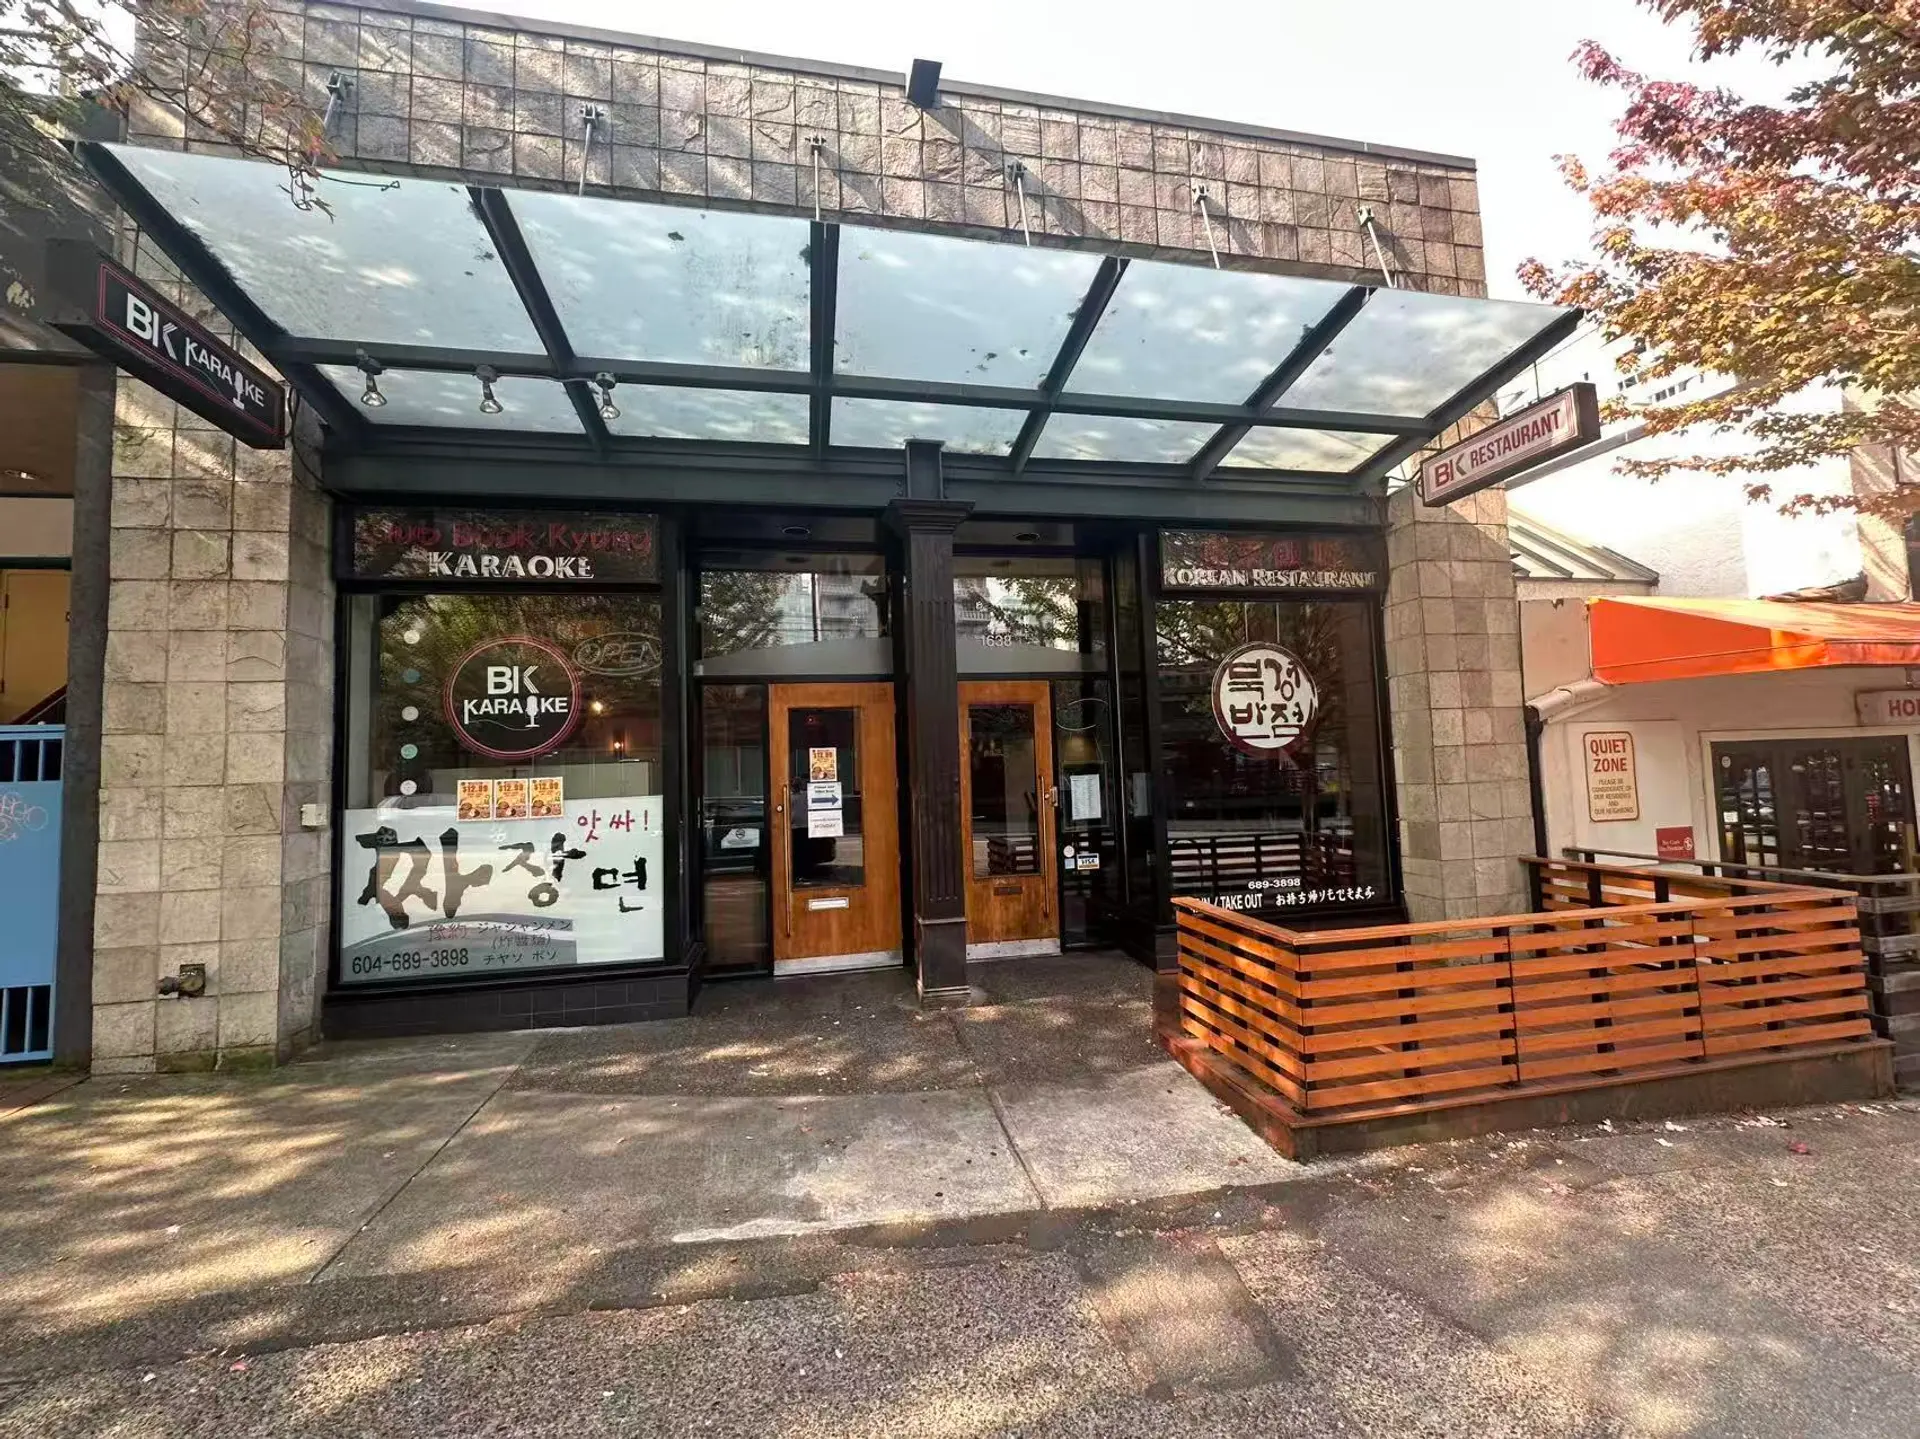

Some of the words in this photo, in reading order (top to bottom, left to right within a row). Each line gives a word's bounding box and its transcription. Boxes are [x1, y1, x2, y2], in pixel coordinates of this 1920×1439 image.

[126, 293, 178, 360] BK
[1434, 453, 1467, 488] BK
[1470, 409, 1561, 469] RESTAURANT
[429, 551, 596, 579] KARAOKE
[1164, 567, 1249, 586] KOREAN
[981, 634, 1012, 647] 1638
[577, 641, 663, 666] OPEN
[487, 666, 540, 695] BK
[1888, 699, 1920, 717] HO
[1590, 739, 1627, 756] QUIET
[1593, 758, 1628, 773] ZONE
[355, 825, 649, 931] 짜장면
[1248, 878, 1301, 890] 689-3898
[1220, 894, 1244, 911] TAKE
[1245, 893, 1263, 909] OUT
[1275, 885, 1376, 907] お持ち帰りもできます
[352, 948, 469, 974] 604-689-3898
